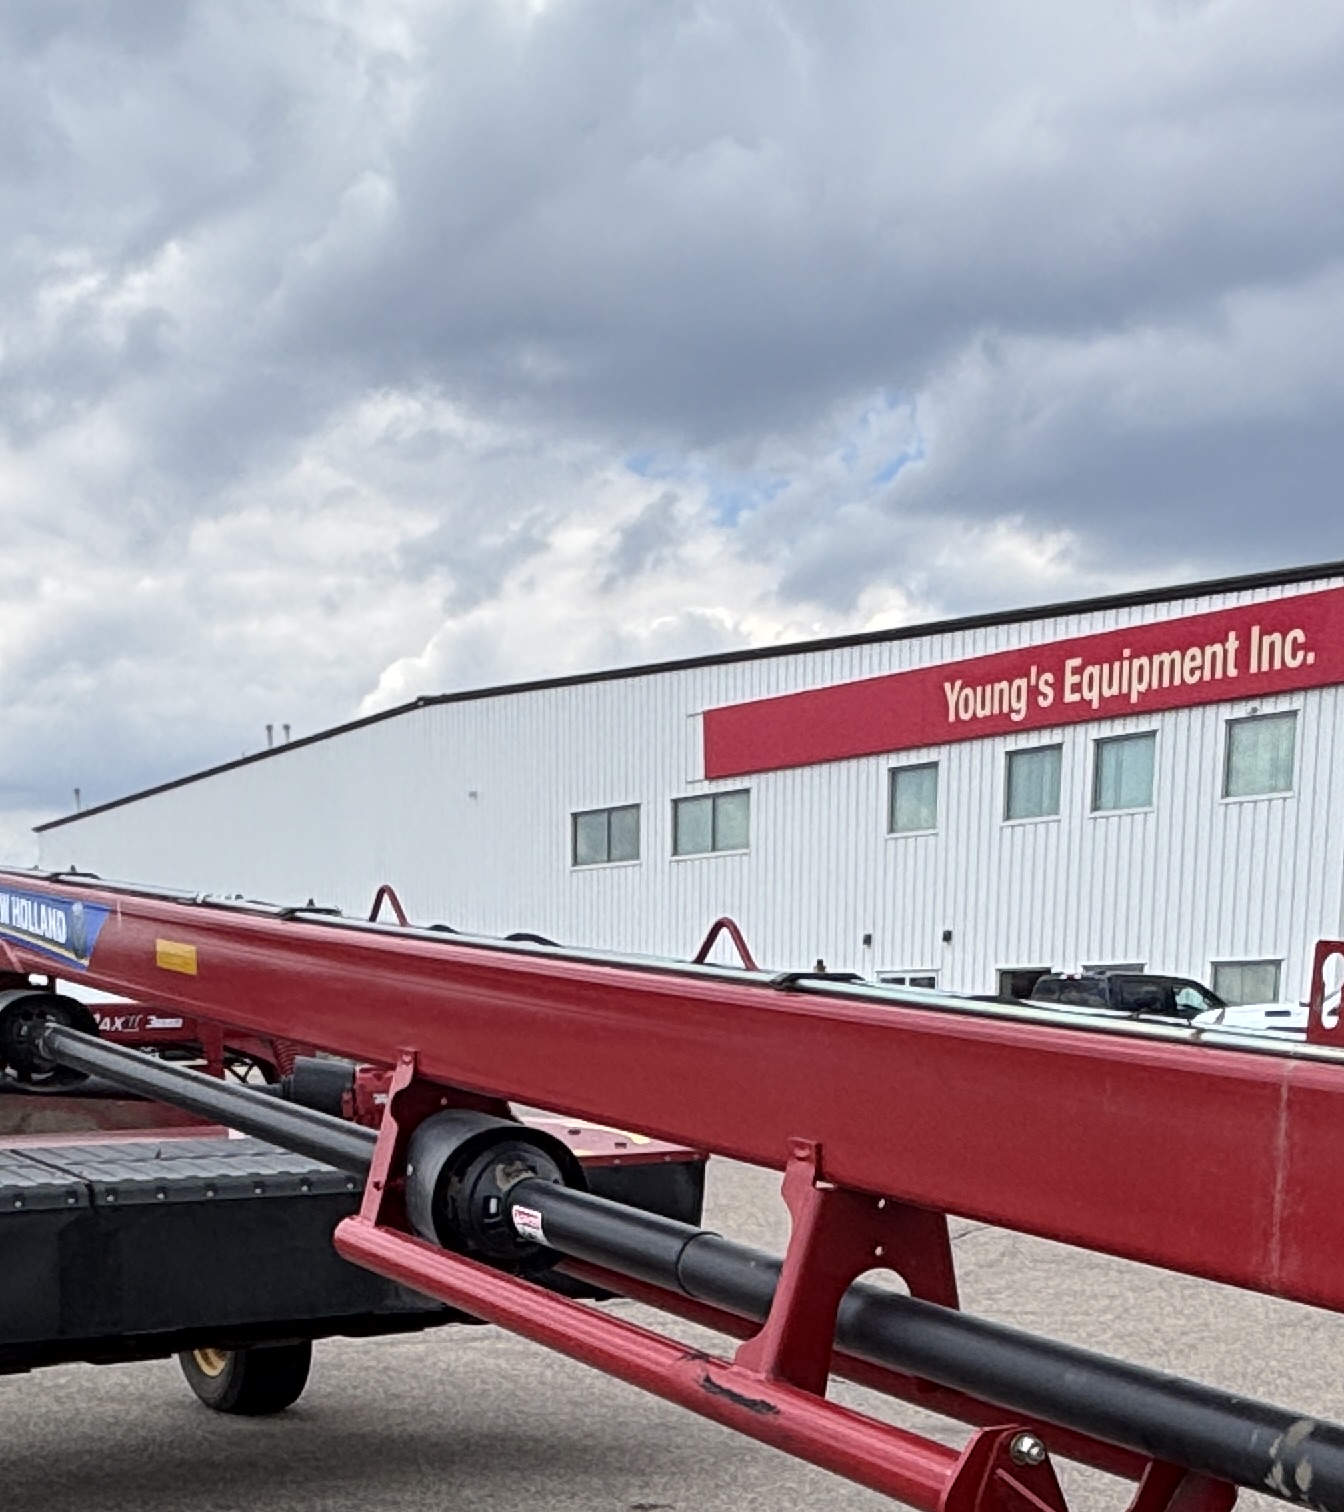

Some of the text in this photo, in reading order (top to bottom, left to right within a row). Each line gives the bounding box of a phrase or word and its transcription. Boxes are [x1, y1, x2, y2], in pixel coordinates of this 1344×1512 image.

[944, 625, 1316, 723] Young's Equipment Inc.
[11, 896, 67, 944] HOLLAND
